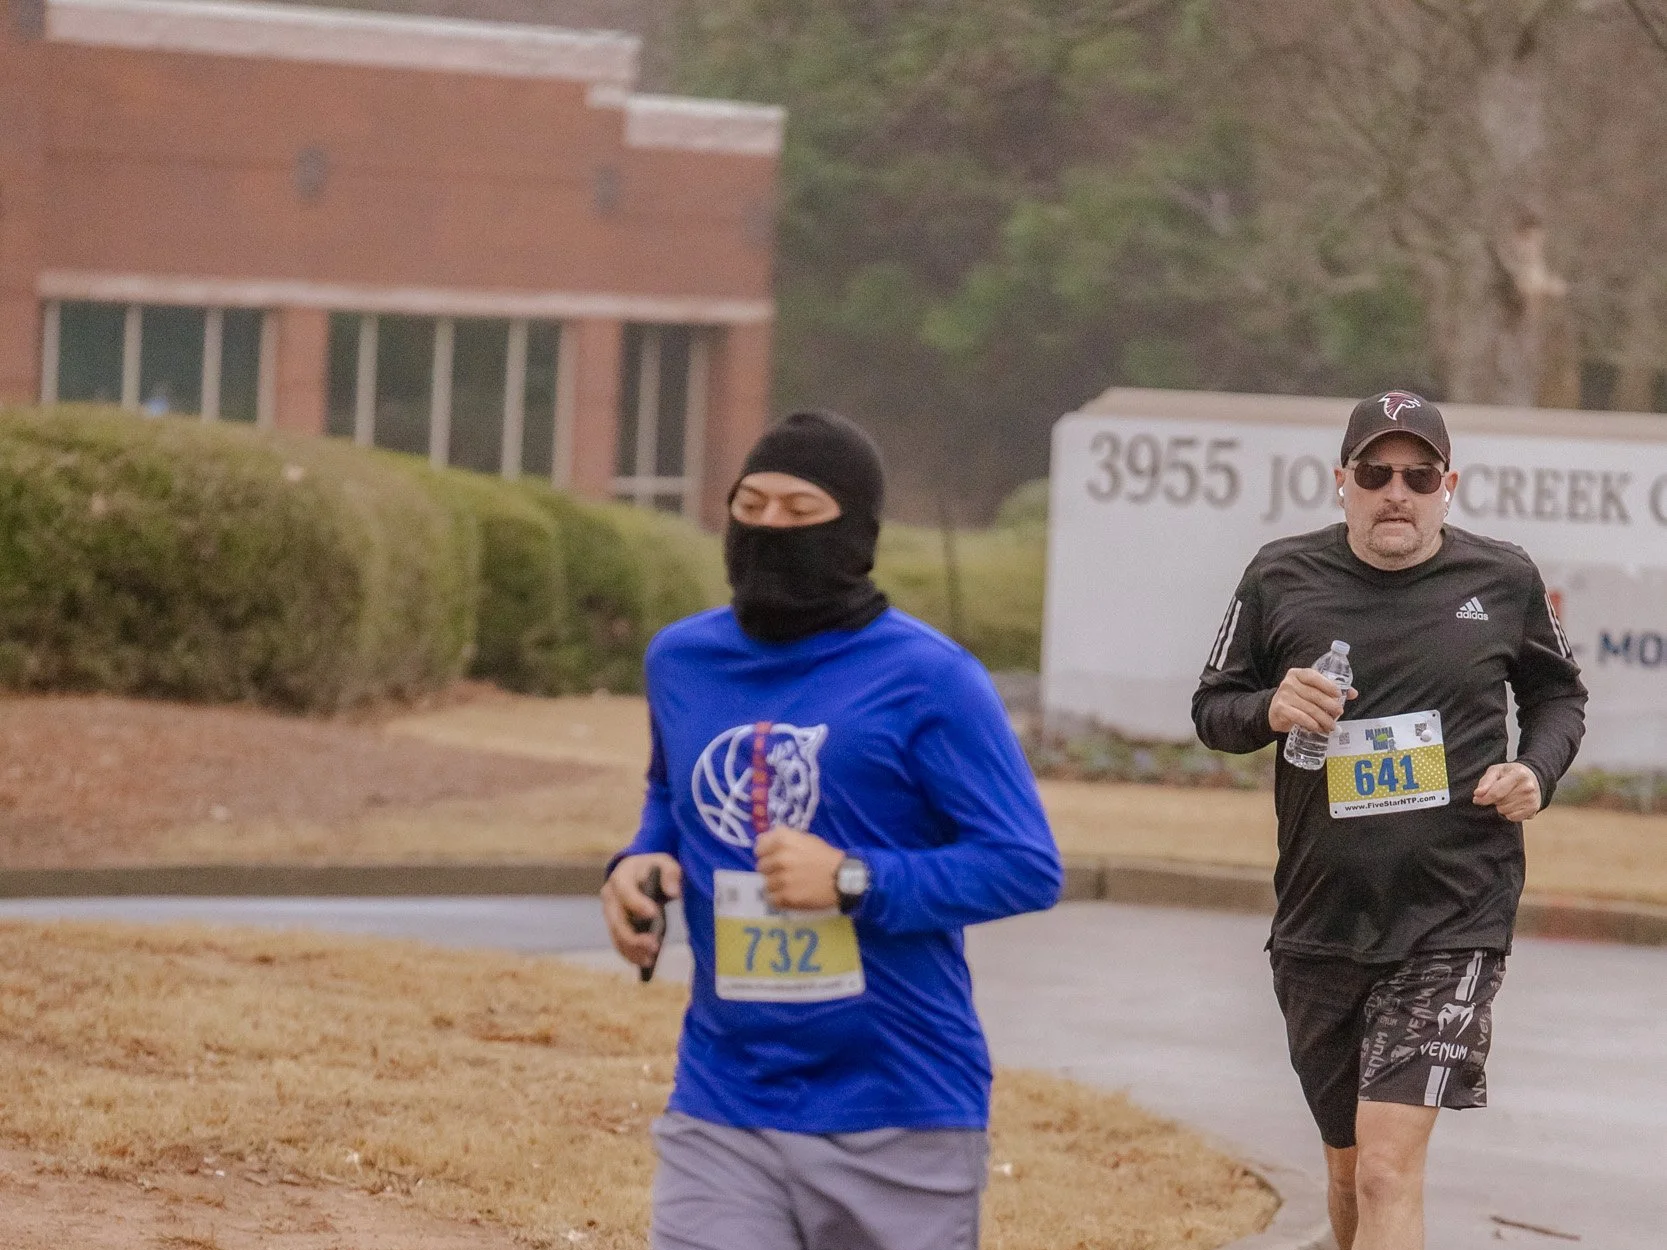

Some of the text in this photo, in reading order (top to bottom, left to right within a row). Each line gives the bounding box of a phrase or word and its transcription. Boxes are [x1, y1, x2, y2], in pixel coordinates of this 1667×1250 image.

[1086, 431, 1241, 510] 3955
[1458, 463, 1632, 525] CREEK
[1456, 609, 1489, 621] adidas
[1354, 754, 1420, 796] 641
[1344, 795, 1437, 812] www.FiveStarNTP.com
[743, 927, 822, 973] 732
[1360, 1031, 1389, 1091] VENUM
[1420, 1040, 1469, 1061] VENUM
